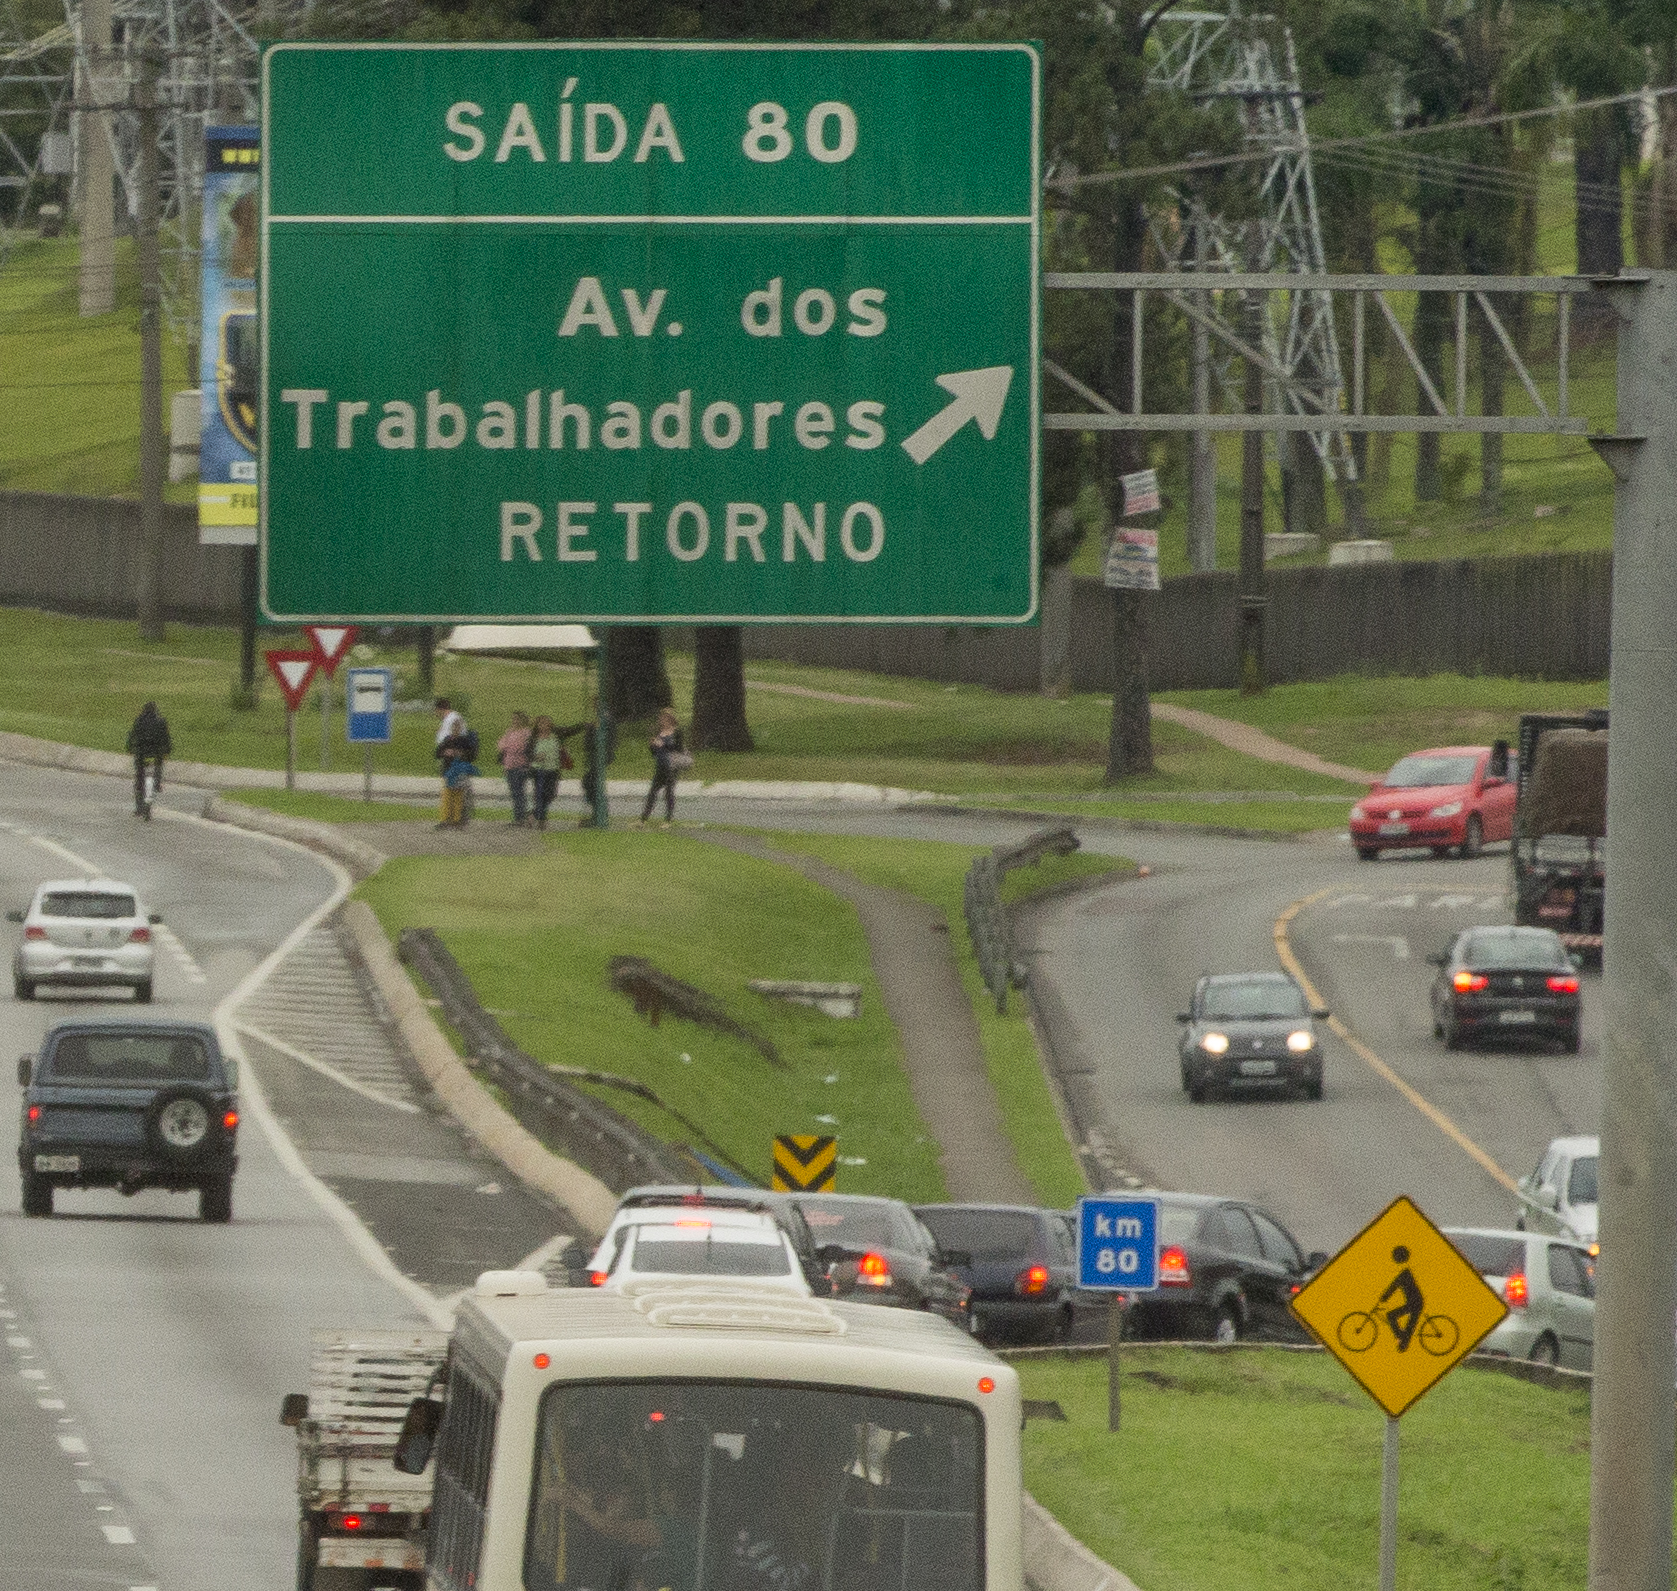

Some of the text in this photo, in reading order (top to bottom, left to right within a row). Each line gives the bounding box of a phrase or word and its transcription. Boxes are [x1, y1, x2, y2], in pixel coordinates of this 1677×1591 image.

[442, 77, 859, 164] SAÍDA 80
[557, 275, 889, 338] Av. dos
[279, 388, 886, 450] Trabalhadores
[498, 500, 885, 563] RETORNO
[1094, 1212, 1143, 1238] km
[1095, 1247, 1140, 1274] 80
